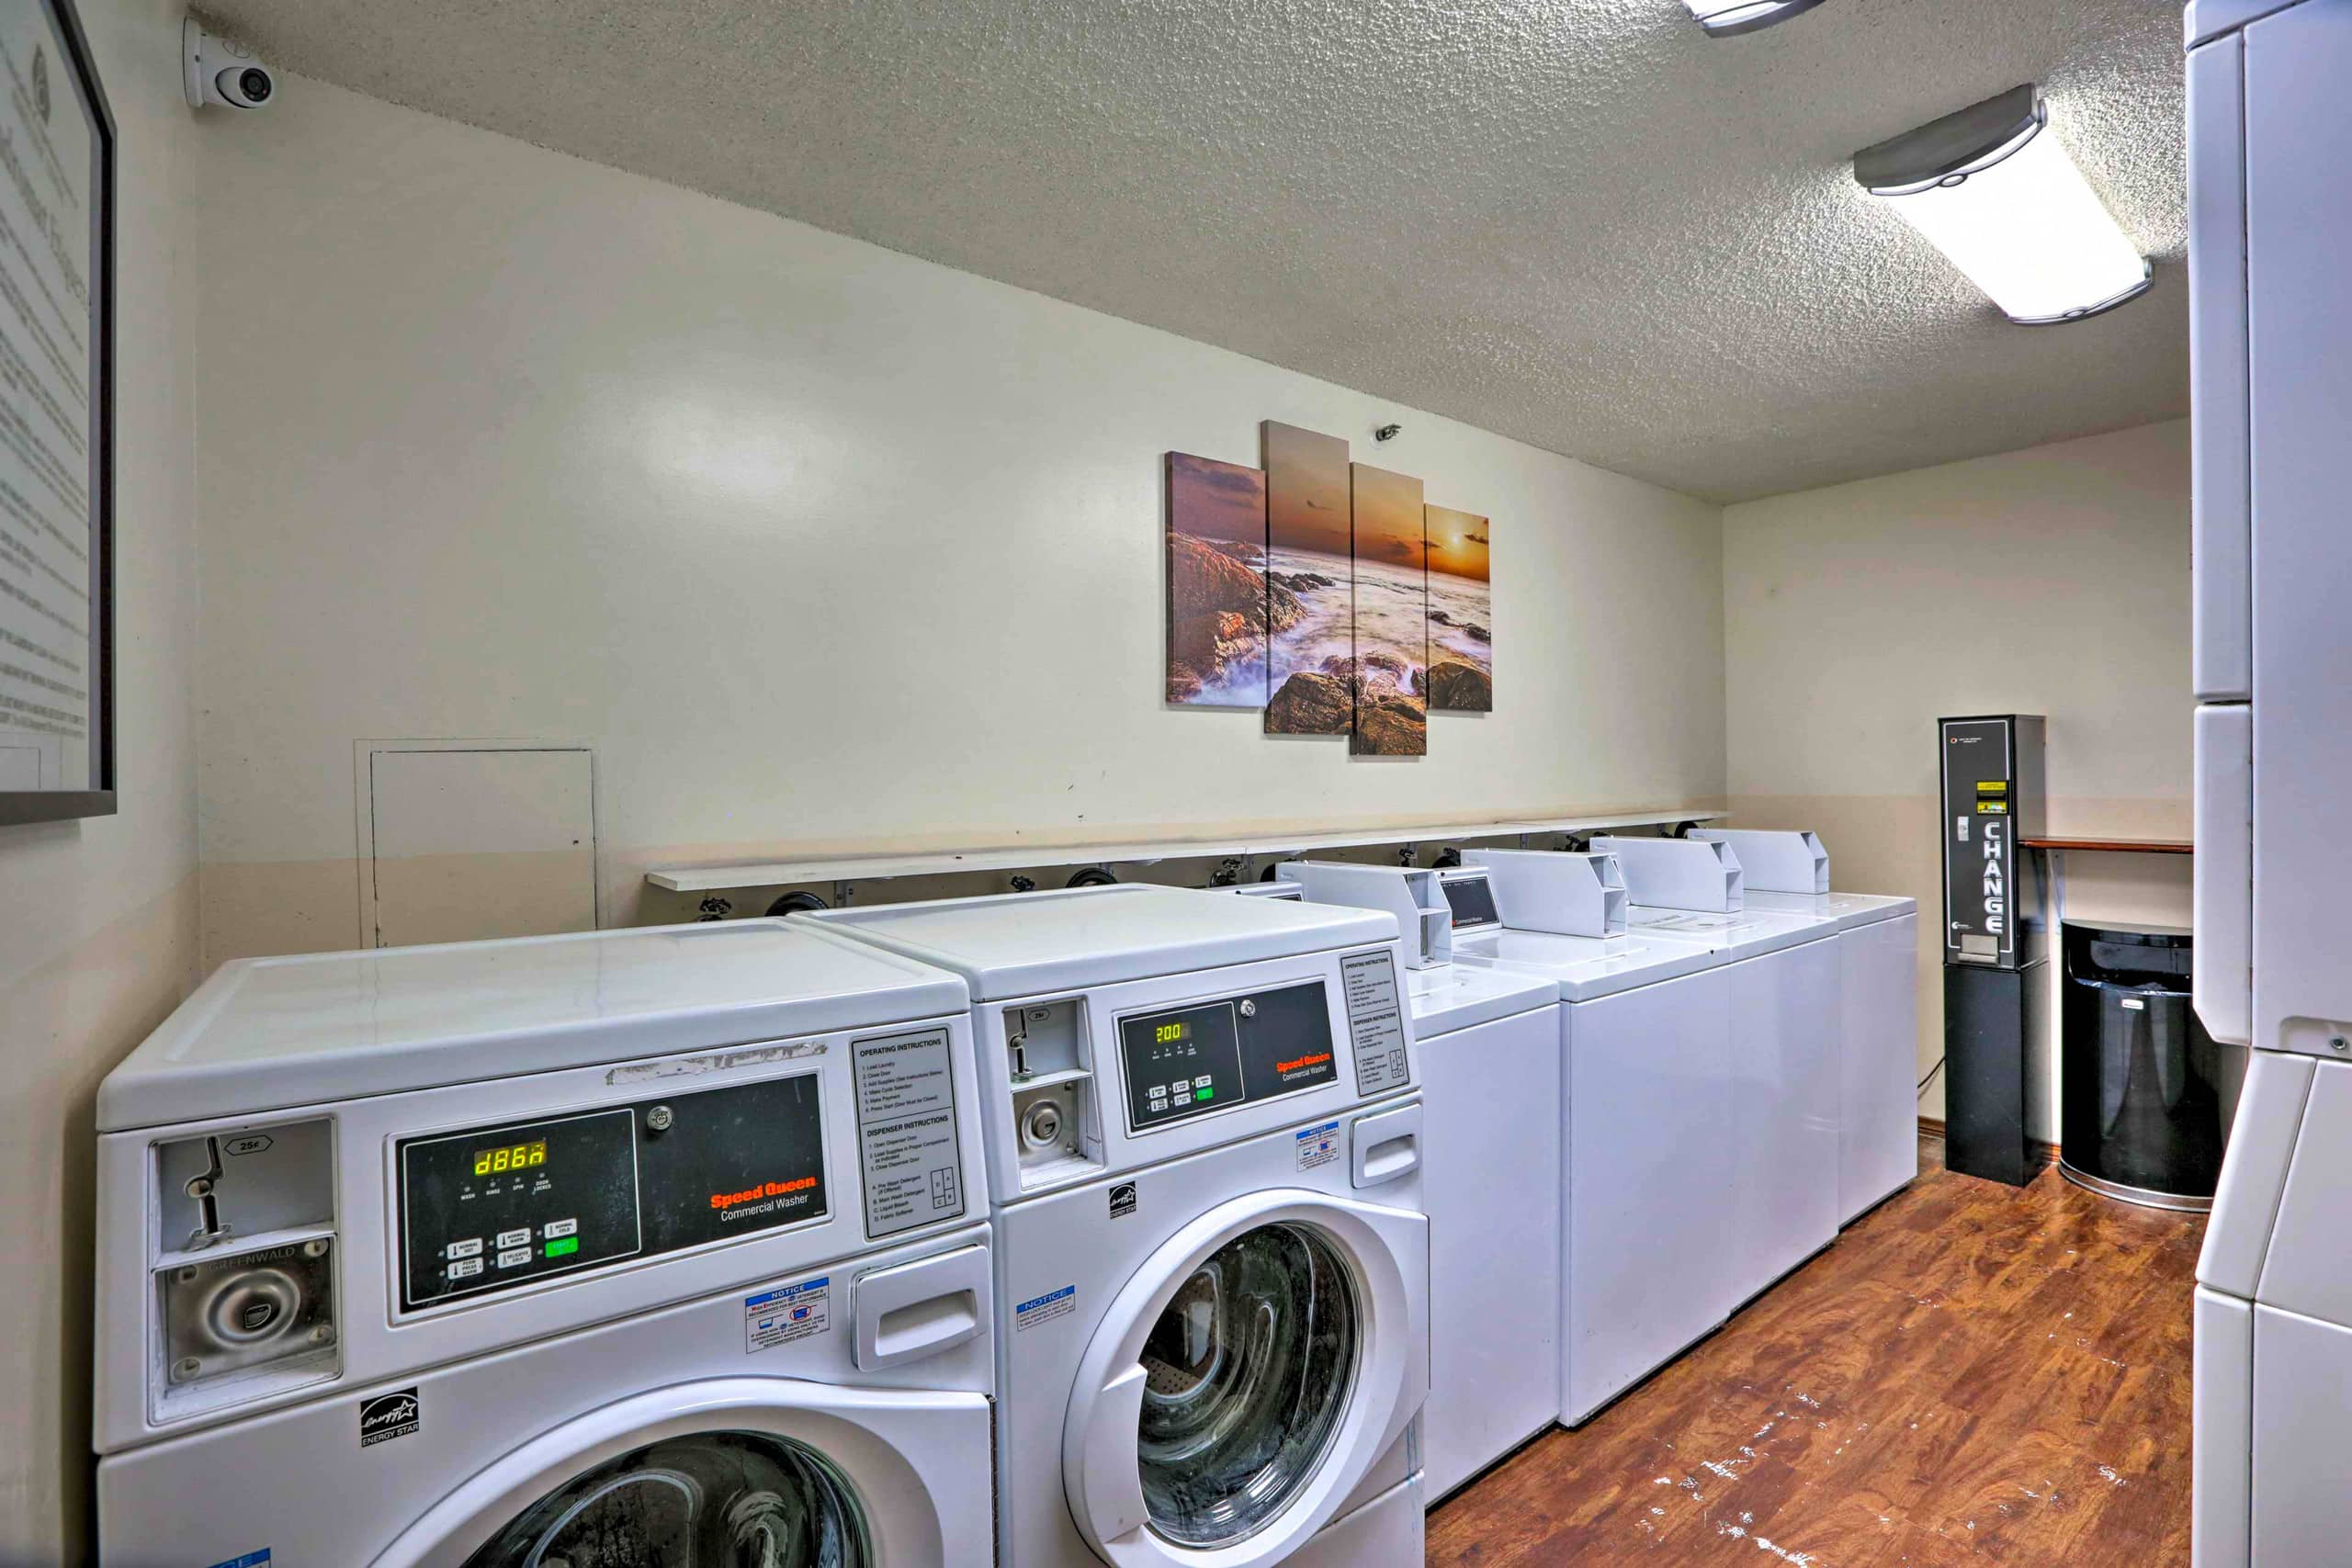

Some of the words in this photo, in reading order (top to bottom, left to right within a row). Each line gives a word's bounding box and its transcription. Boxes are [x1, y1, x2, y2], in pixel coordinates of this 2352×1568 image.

[1984, 821, 2003, 934] CHANGE
[860, 1045, 896, 1057] OPERATING
[898, 1039, 941, 1051] INSTRUCTIONS
[1276, 1057, 1304, 1073] Speed
[1305, 1053, 1330, 1065] Queen
[1283, 1068, 1309, 1081] Commercial
[1310, 1065, 1327, 1074] Washer
[867, 1123, 903, 1137] DISPENSER
[904, 1115, 948, 1129] INSTRUCTIONS
[240, 1141, 260, 1150] 25¢
[710, 1185, 763, 1209] Speed
[765, 1176, 817, 1195] Queen
[720, 1201, 774, 1222] Commercial
[775, 1194, 808, 1209] Washer
[772, 1285, 805, 1299] NOTICE
[1024, 1290, 1067, 1309] NOTICE
[362, 1430, 396, 1446] ENERGY
[397, 1424, 419, 1436] STAR
